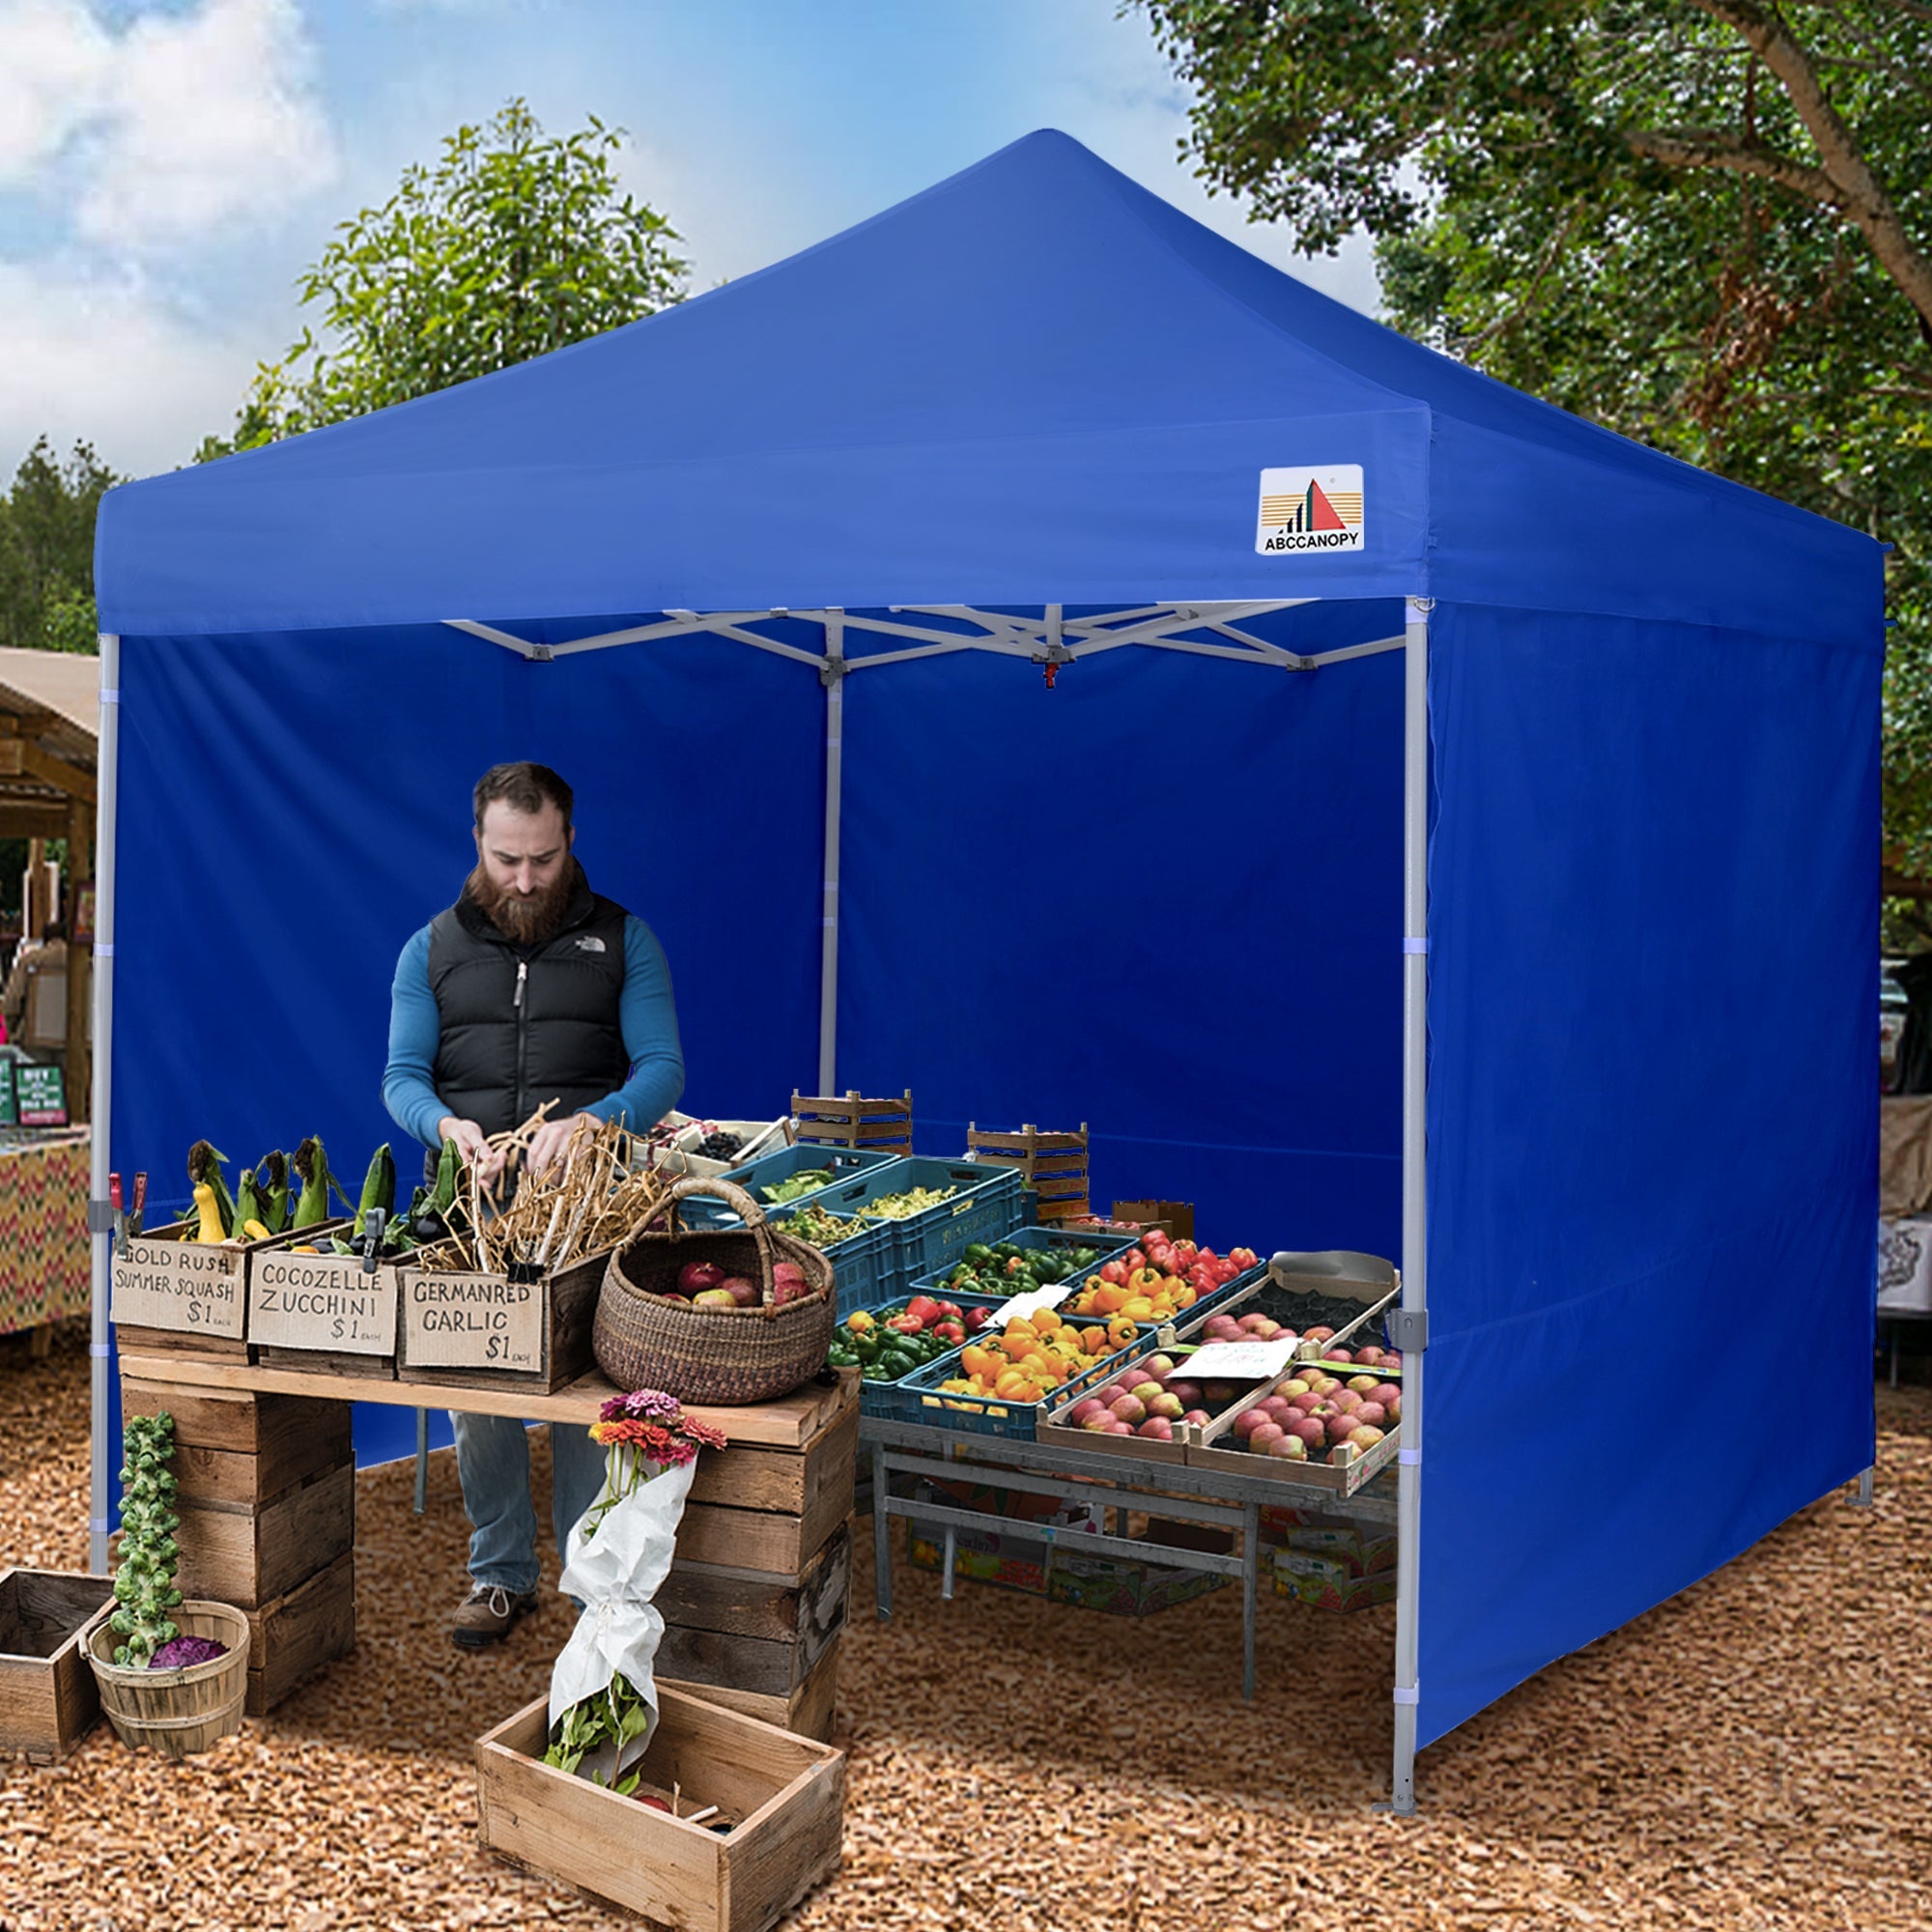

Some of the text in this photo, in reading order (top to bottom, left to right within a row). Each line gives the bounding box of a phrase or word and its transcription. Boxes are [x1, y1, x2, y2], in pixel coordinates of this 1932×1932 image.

[1264, 532, 1359, 551] ABCCANOPY
[179, 1253, 229, 1275] RUSH
[115, 1268, 235, 1304] SUMMER SQUASH
[262, 1263, 383, 1292] COCOZELLE
[186, 1300, 212, 1324] $1
[259, 1289, 376, 1317] ZUCCHINI
[330, 1318, 358, 1340] $1
[422, 1309, 508, 1332] GARLIC
[485, 1333, 509, 1360] $1
